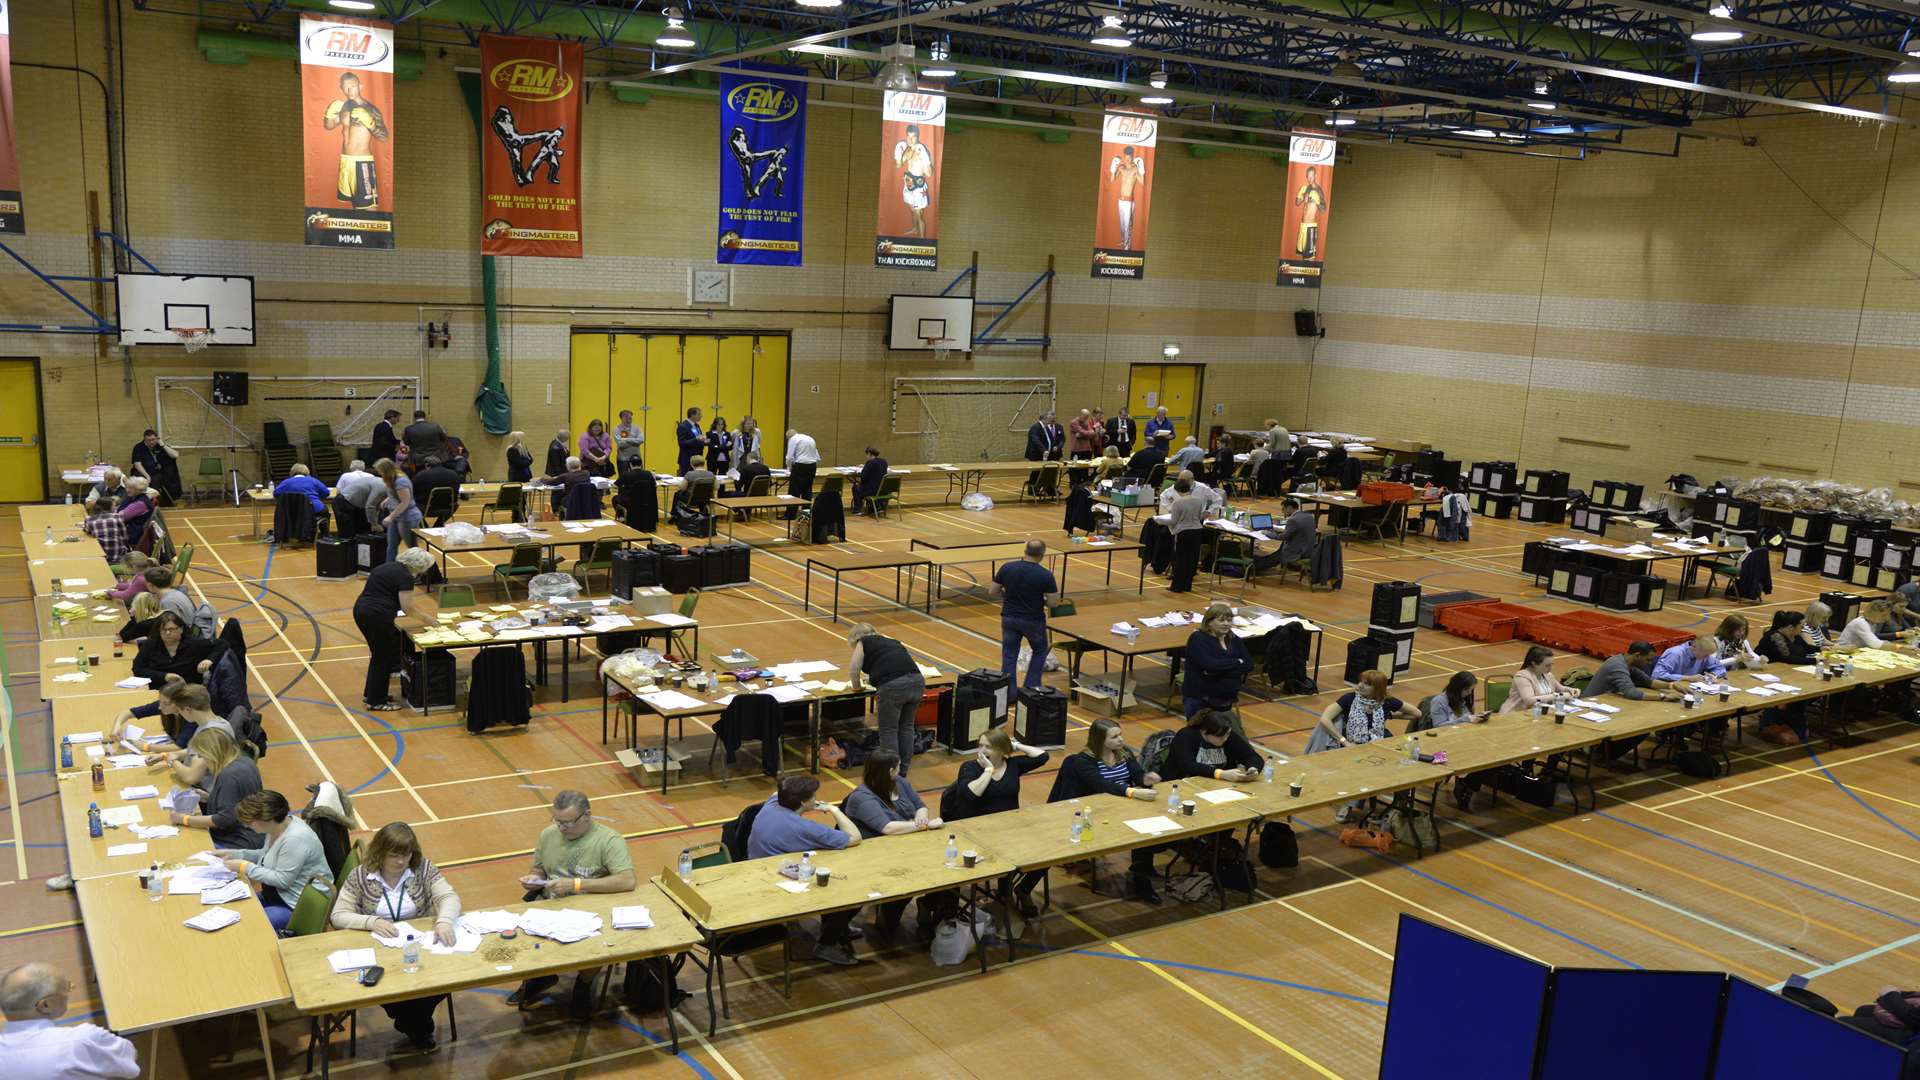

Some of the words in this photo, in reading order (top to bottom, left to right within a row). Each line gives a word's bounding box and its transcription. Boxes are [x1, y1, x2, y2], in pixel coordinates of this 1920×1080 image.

[326, 31, 372, 54] RM
[510, 64, 557, 88] RM
[744, 87, 785, 109] RM
[901, 93, 932, 111] RM
[1119, 116, 1145, 133] RM
[1302, 138, 1325, 153] RM
[513, 194, 535, 203] DOES
[537, 196, 553, 204] NOT
[556, 197, 577, 206] FEAR
[338, 234, 362, 244] MMA
[878, 256, 894, 264] THAI
[895, 257, 936, 267] KICKBOXING
